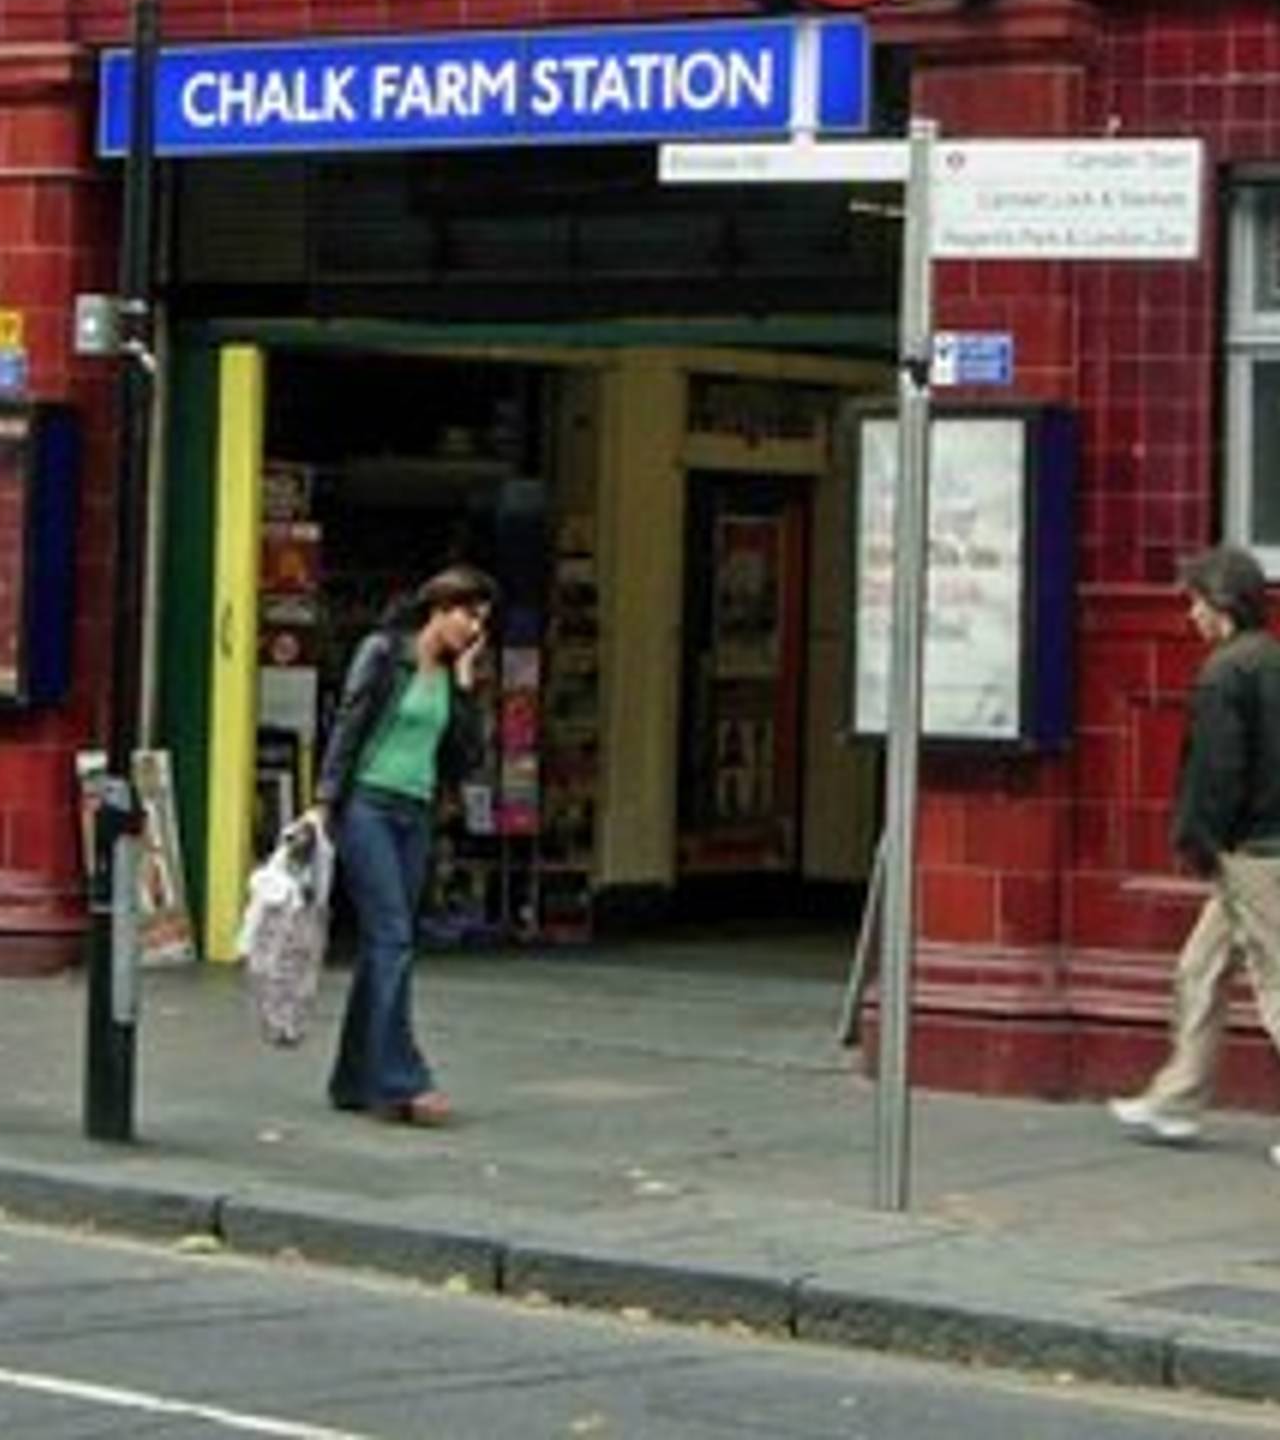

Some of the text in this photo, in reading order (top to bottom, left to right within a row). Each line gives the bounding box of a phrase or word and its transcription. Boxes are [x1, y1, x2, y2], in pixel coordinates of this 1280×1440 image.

[181, 48, 773, 126] CHALK FARM STATION
